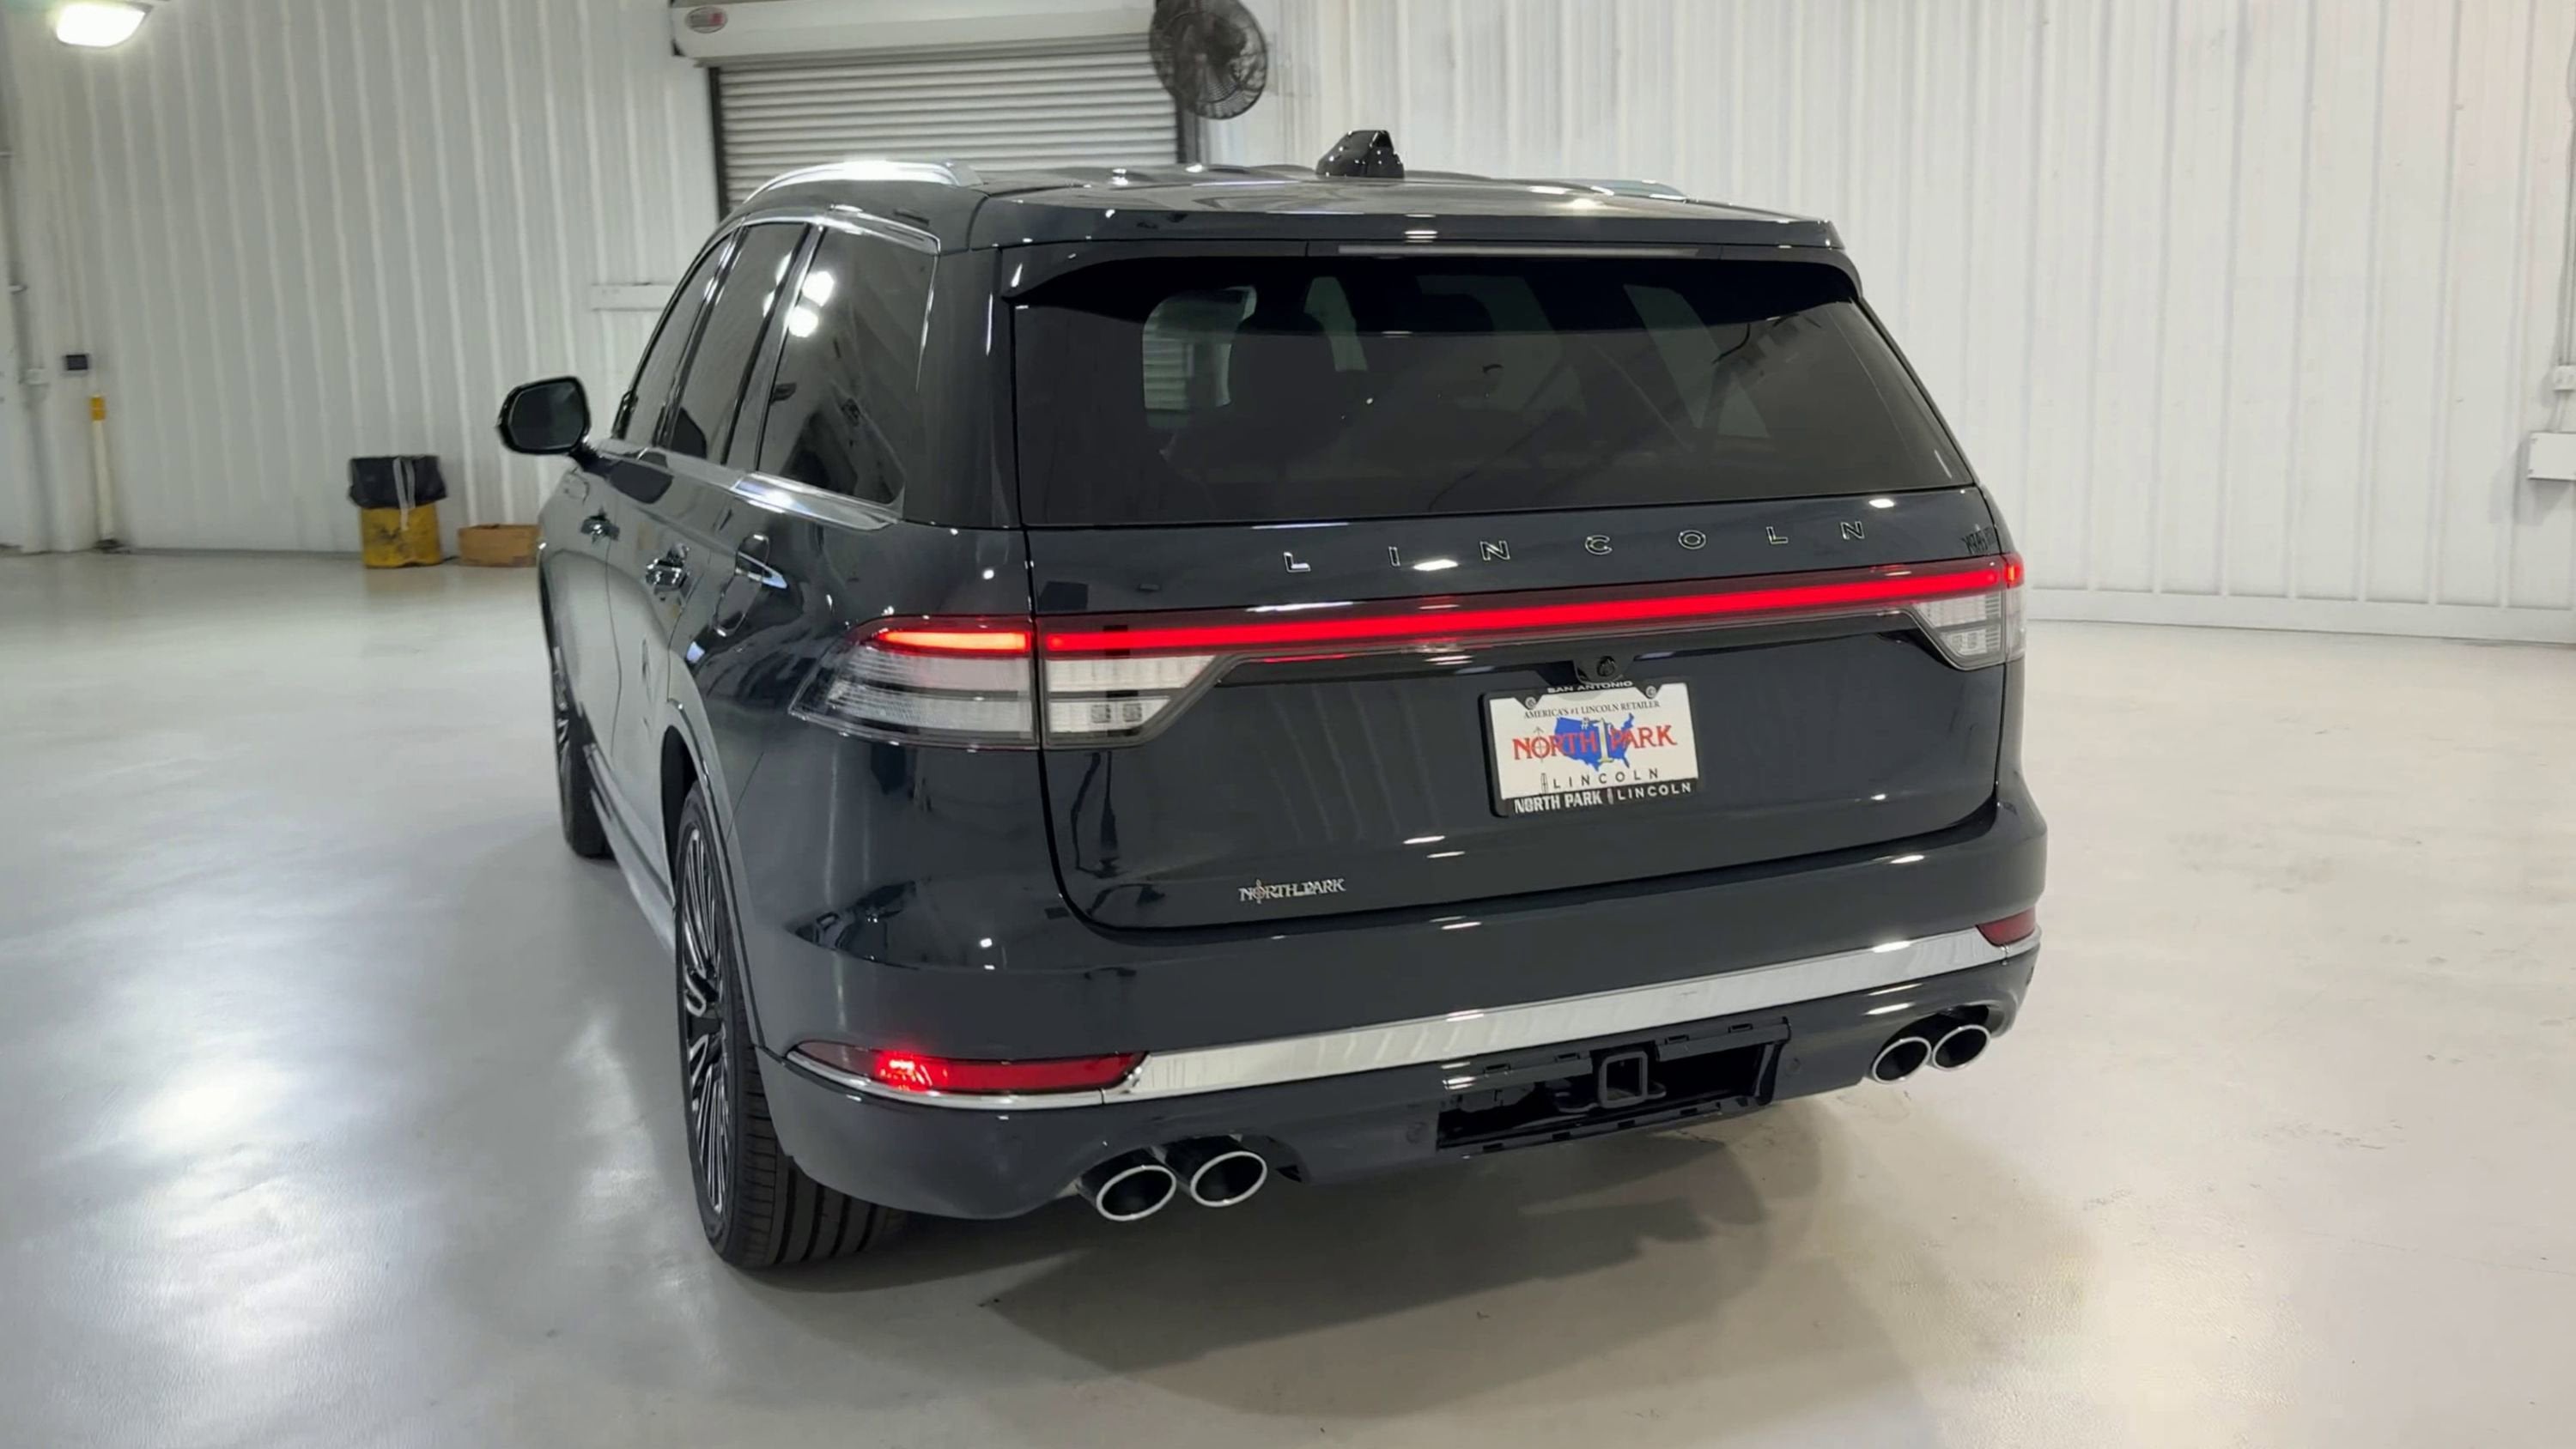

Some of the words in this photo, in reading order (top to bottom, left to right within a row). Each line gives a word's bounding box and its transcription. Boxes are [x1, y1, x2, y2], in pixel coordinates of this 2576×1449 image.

[1283, 520, 1866, 573] LINCOLN
[1547, 685, 1573, 694] SAN
[1577, 680, 1633, 692] ANTONIO
[1524, 708, 1570, 719] AMERICA'S
[1571, 706, 1579, 715] #1
[1581, 703, 1619, 715] LINCOLN
[1620, 700, 1661, 712] RETAILER
[1512, 731, 1599, 761] NORTH
[1609, 724, 1677, 751] PARK
[1553, 768, 1659, 789] LINCOLN
[1514, 792, 1561, 814] NORTH
[1564, 790, 1603, 808] PARK
[1617, 782, 1692, 801] LINCOLN
